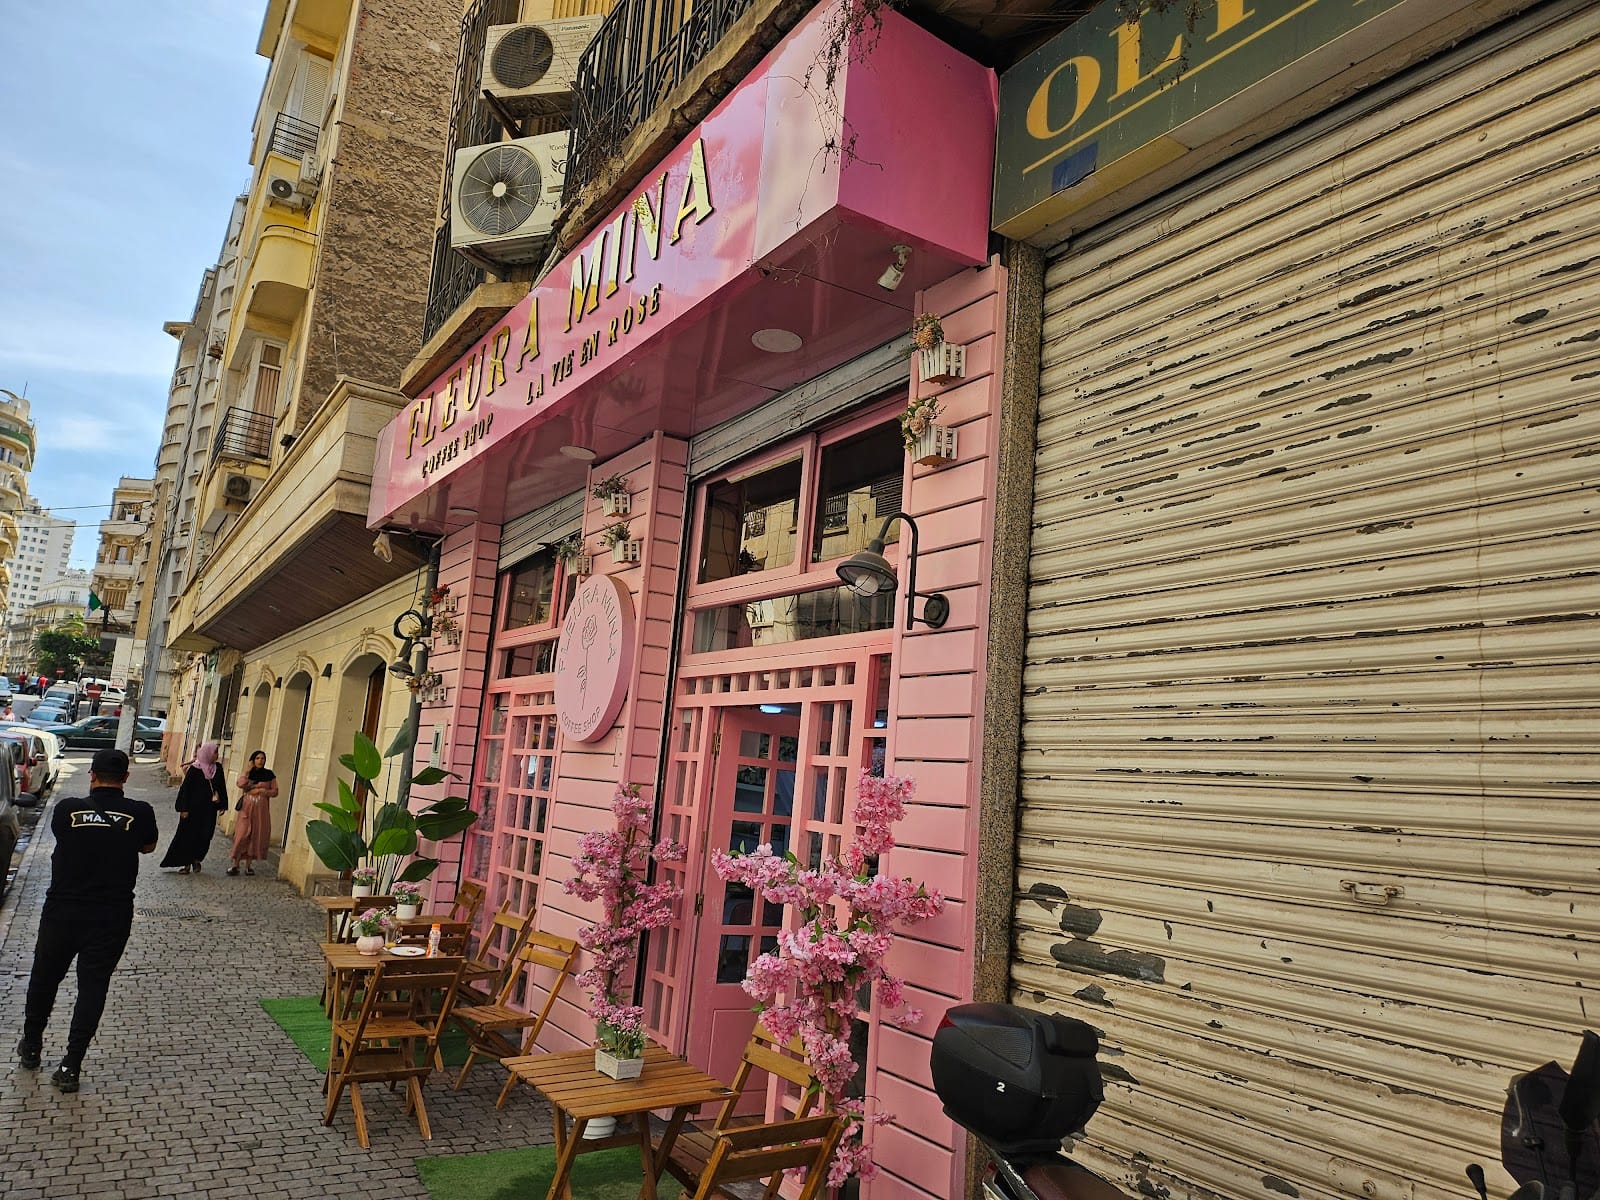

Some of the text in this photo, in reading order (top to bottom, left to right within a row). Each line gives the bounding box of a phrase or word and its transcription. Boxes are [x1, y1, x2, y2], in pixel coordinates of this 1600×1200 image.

[405, 137, 714, 460] FLEURA MINA
[526, 283, 663, 405] LA VIE EN ROSE
[422, 413, 494, 478] COFFEE SHOP
[558, 583, 618, 675] FLEURA MINA
[562, 706, 601, 734] COFFEE SHOP
